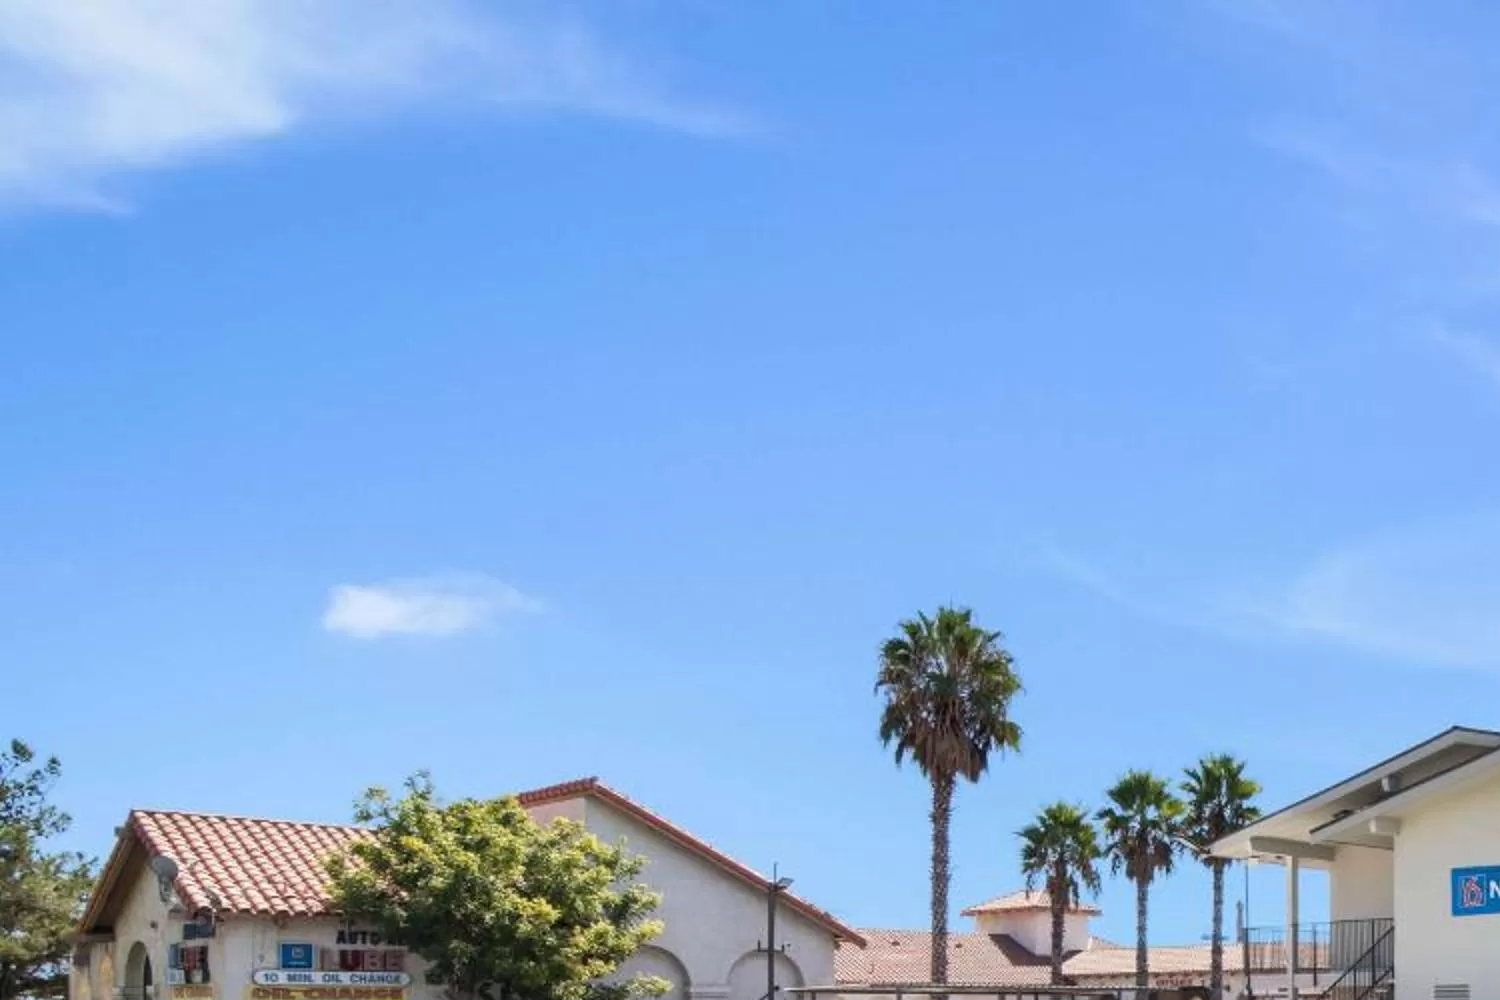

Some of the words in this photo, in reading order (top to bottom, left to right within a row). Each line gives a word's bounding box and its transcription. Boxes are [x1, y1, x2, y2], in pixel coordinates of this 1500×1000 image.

[336, 930, 381, 944] AUTO
[320, 949, 404, 970] LUBE
[263, 974, 279, 983] 10
[322, 974, 342, 983] OIL
